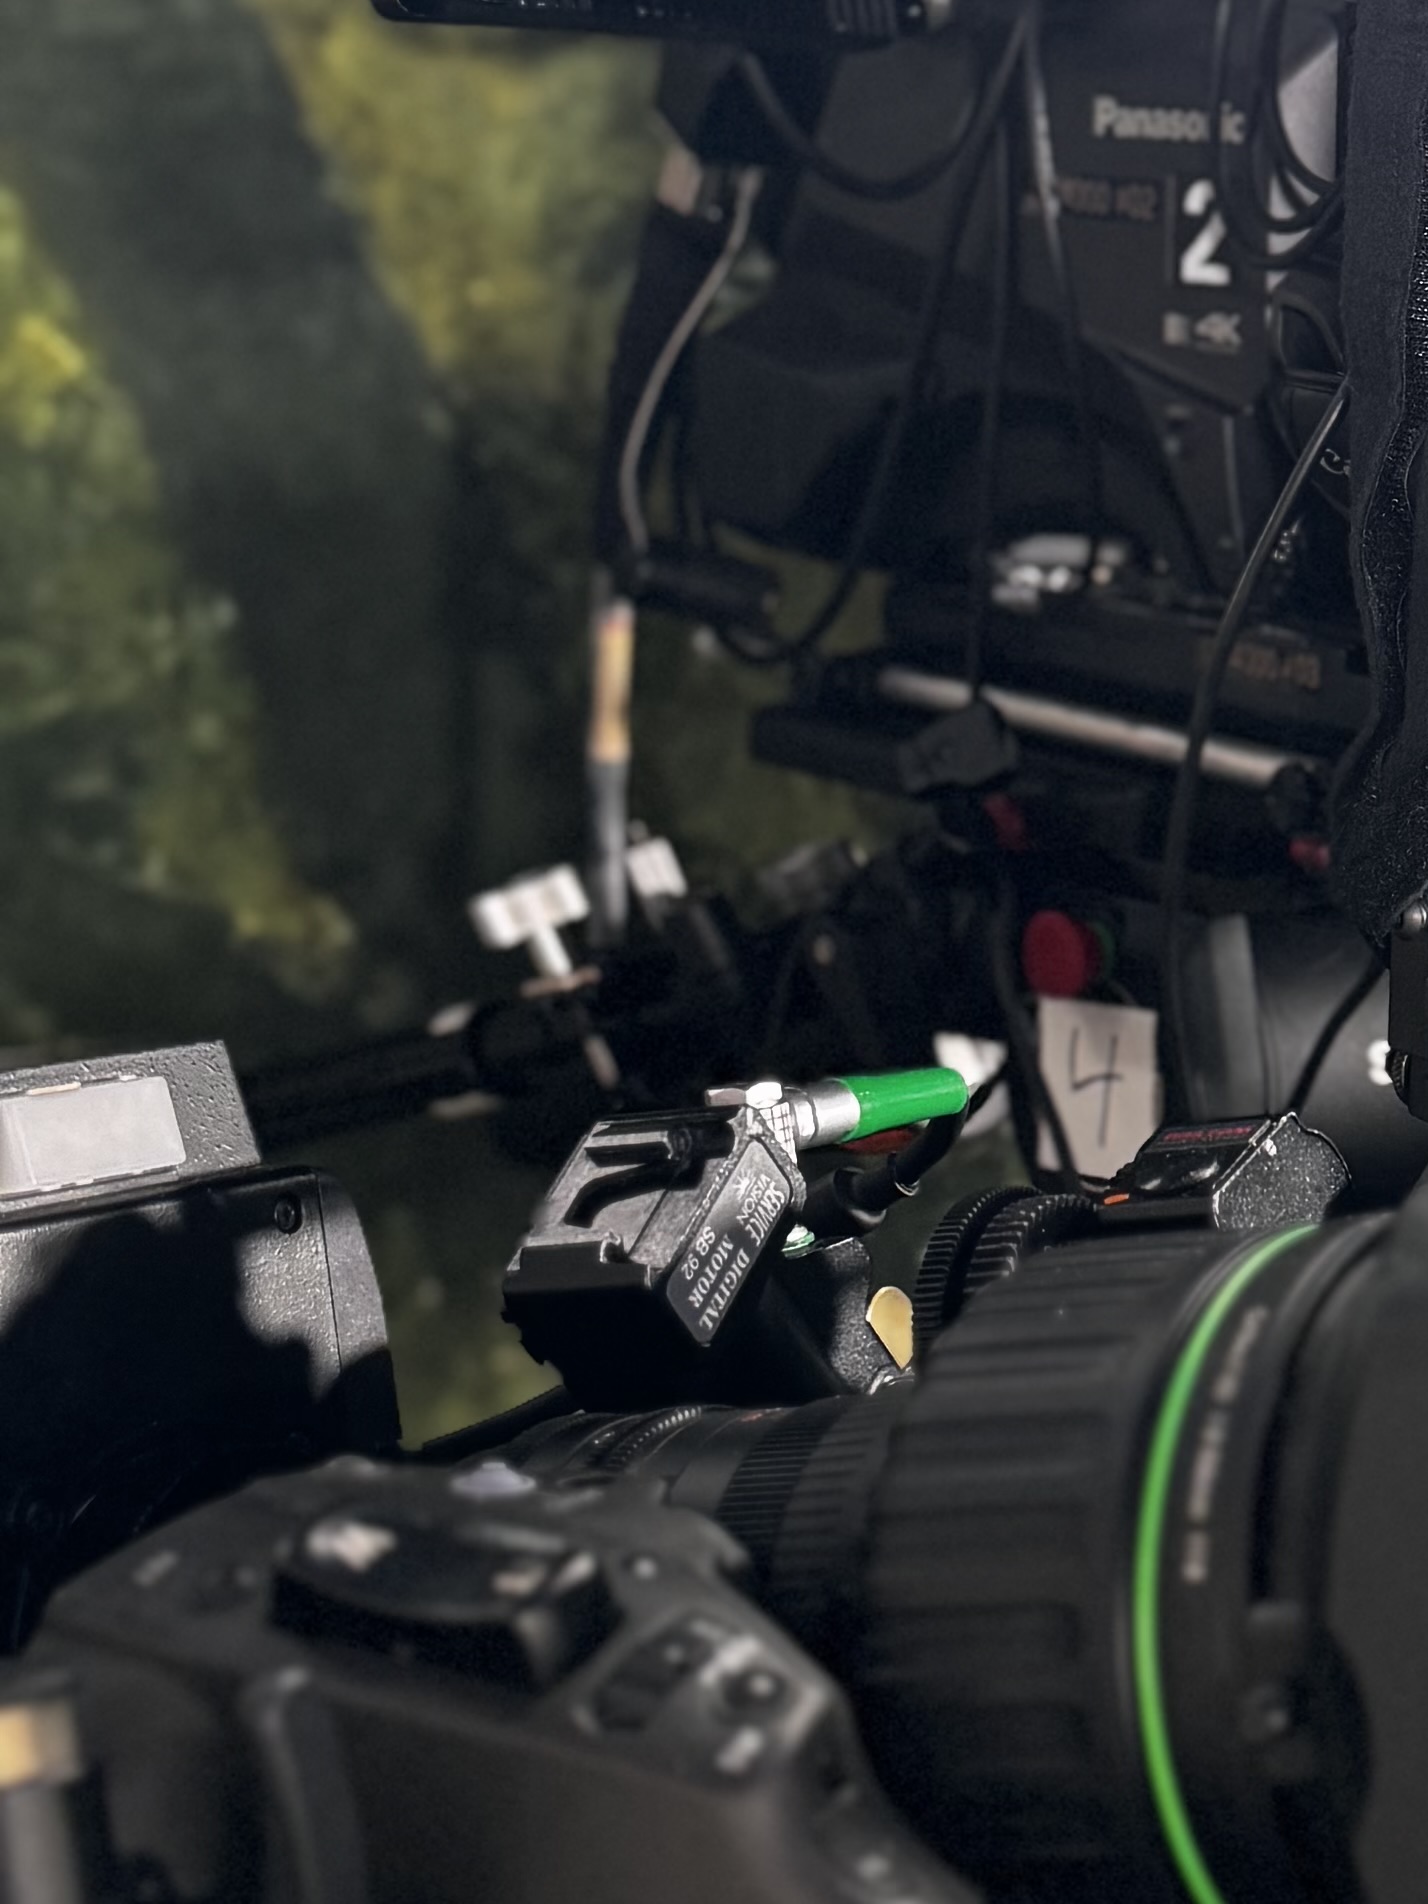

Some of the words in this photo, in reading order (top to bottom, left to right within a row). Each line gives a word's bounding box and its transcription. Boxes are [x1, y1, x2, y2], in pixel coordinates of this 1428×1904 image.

[1092, 93, 1246, 144] Panasoic
[1179, 179, 1231, 287] 2
[1067, 1026, 1123, 1150] 4
[736, 1173, 772, 1227] VISION
[744, 1181, 786, 1247] SERVICE
[681, 1253, 700, 1281] 92
[688, 1234, 735, 1308] MOTOR
[699, 1247, 751, 1331] DIGITAL
